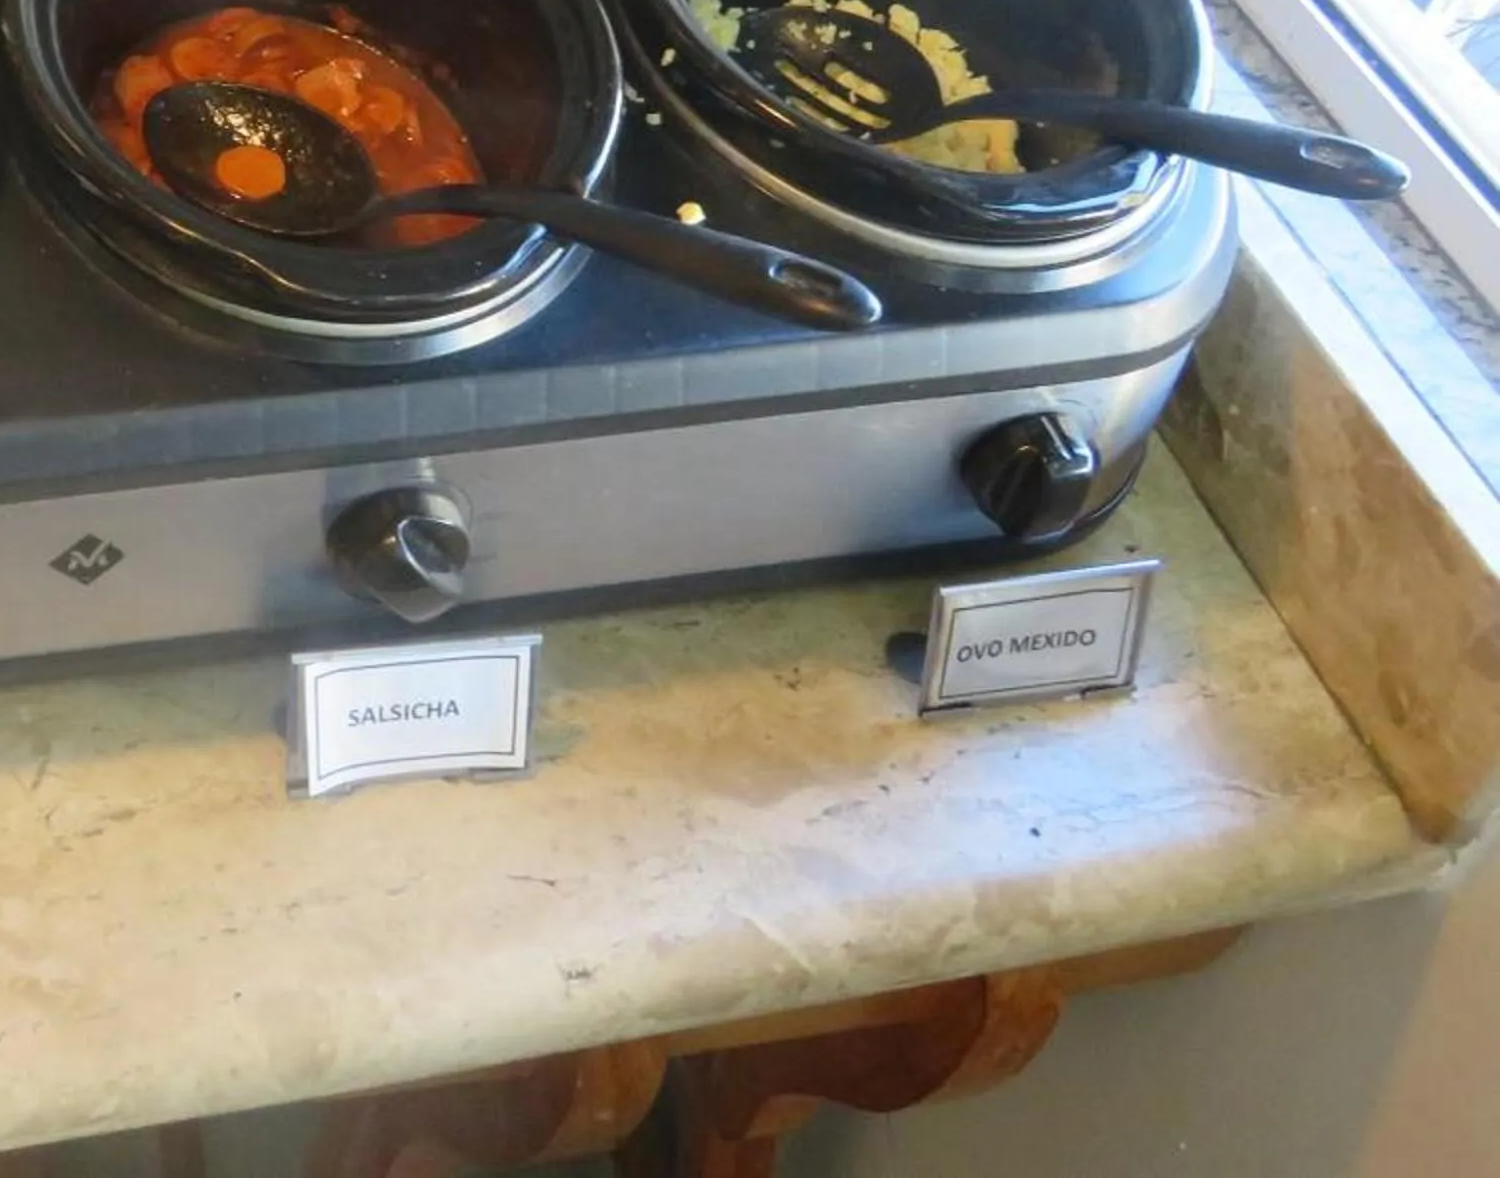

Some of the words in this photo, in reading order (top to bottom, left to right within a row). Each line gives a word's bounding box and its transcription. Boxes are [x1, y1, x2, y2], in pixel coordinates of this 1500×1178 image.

[956, 640, 1003, 663] OVO
[1009, 629, 1097, 655] MEXIDO
[348, 699, 461, 727] SALSICHA
